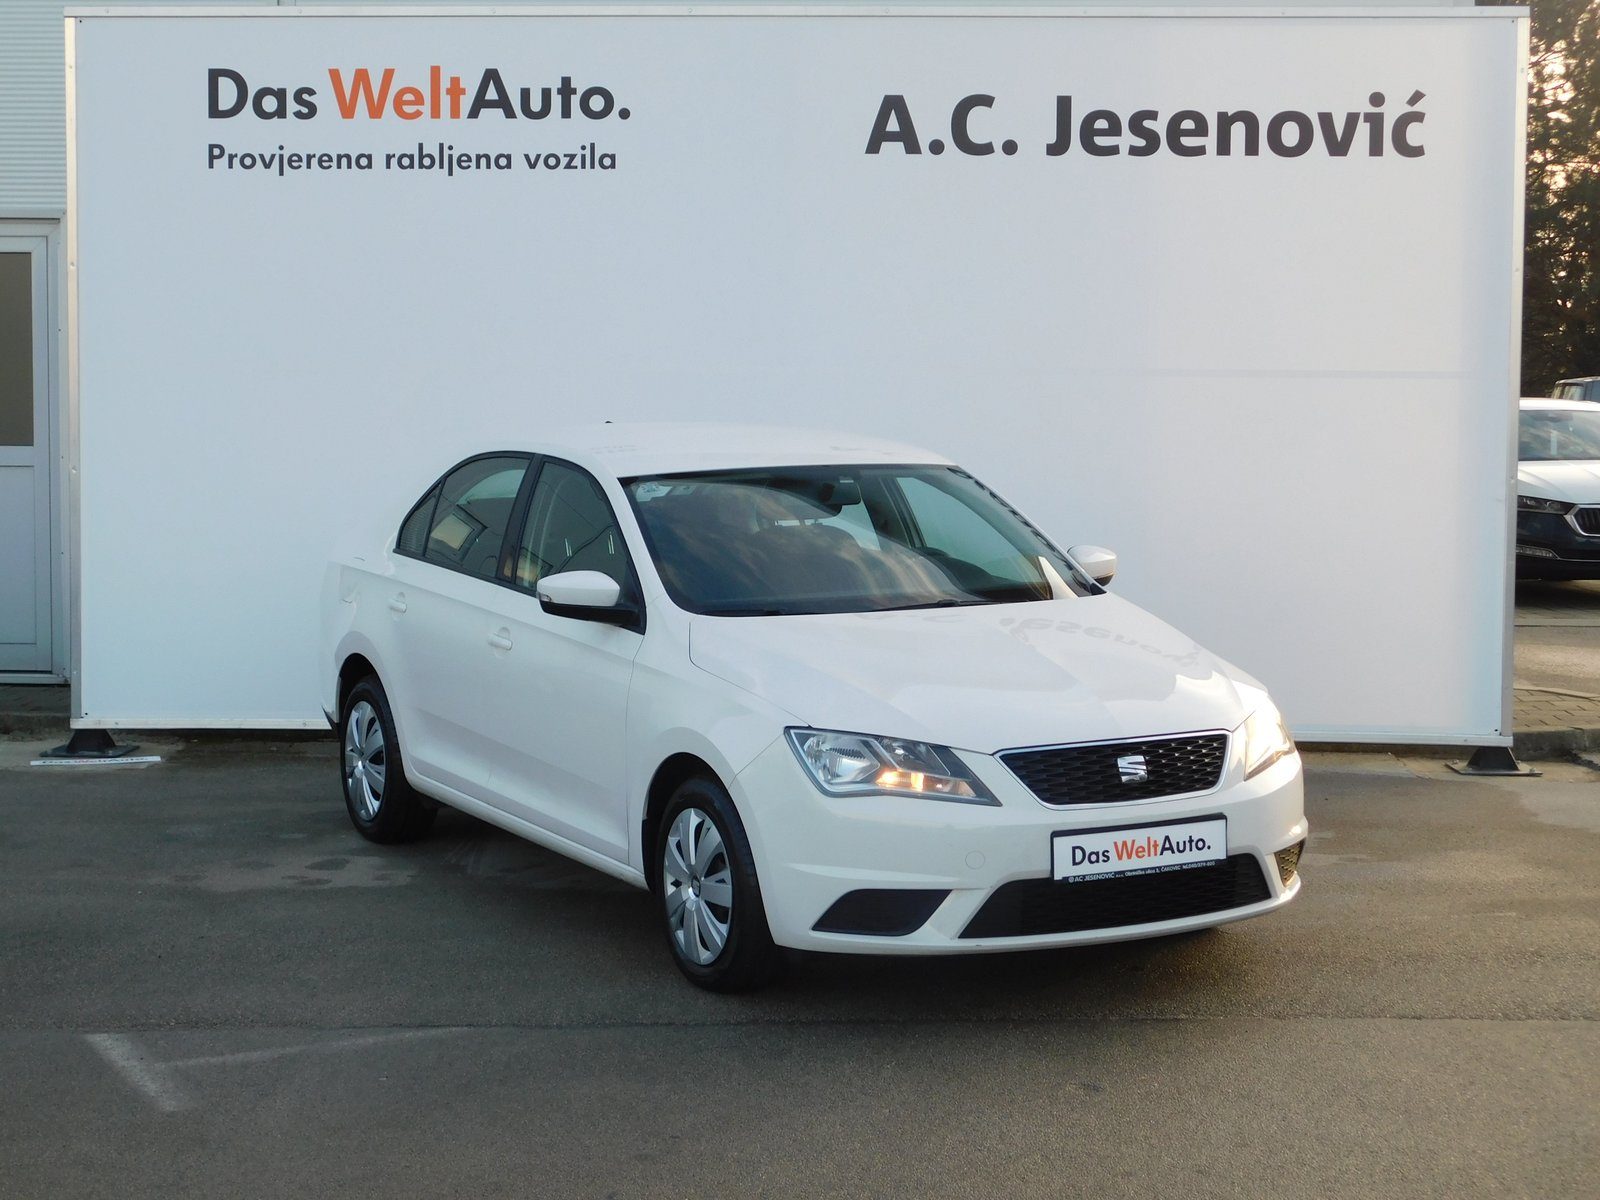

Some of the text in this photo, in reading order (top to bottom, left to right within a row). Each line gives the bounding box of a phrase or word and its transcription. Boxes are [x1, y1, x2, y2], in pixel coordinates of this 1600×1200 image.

[208, 65, 630, 120] Das WeltAuto.
[865, 90, 1426, 158] A.C. Jesenović
[208, 143, 616, 176] Provjerena rabljena vozila
[1071, 835, 1211, 866] Das WeltAuto.
